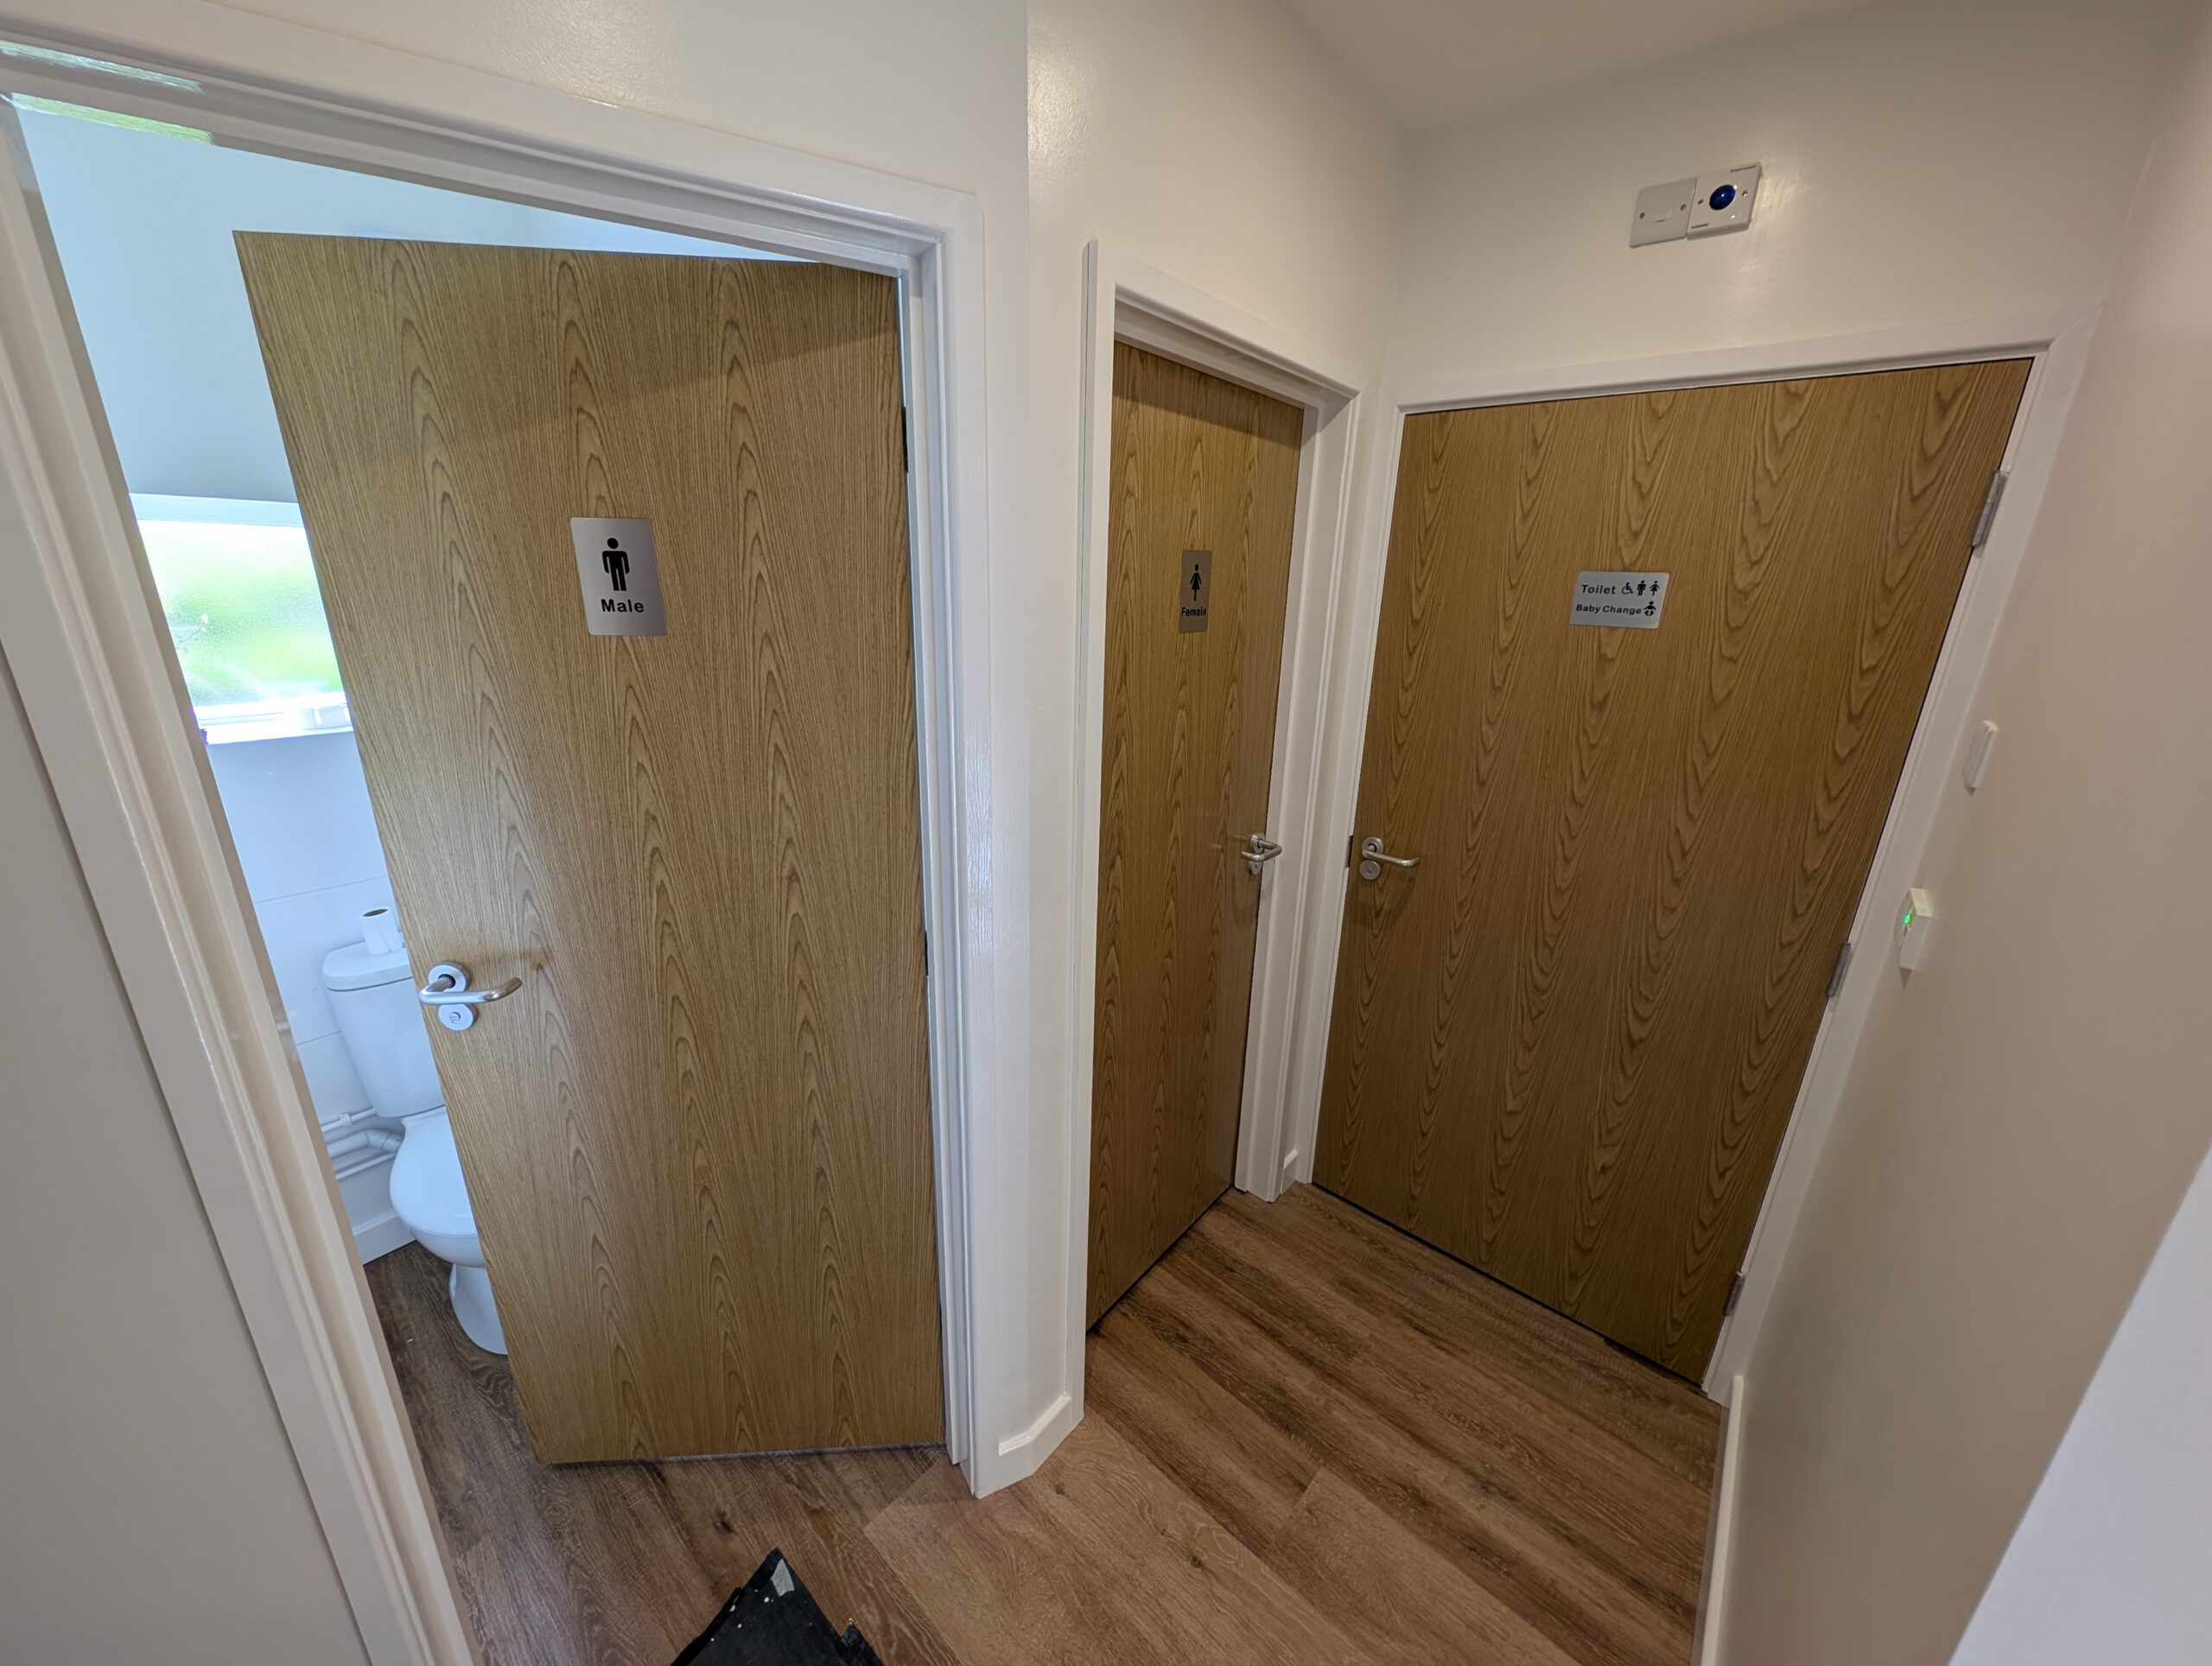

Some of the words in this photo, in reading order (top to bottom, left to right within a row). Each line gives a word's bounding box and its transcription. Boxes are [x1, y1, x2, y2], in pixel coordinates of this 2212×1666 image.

[1581, 584, 1616, 595] Toilet
[601, 599, 645, 613] Male
[1576, 604, 1600, 614] Baby
[1603, 605, 1642, 615] Change
[1181, 607, 1207, 617] Female
